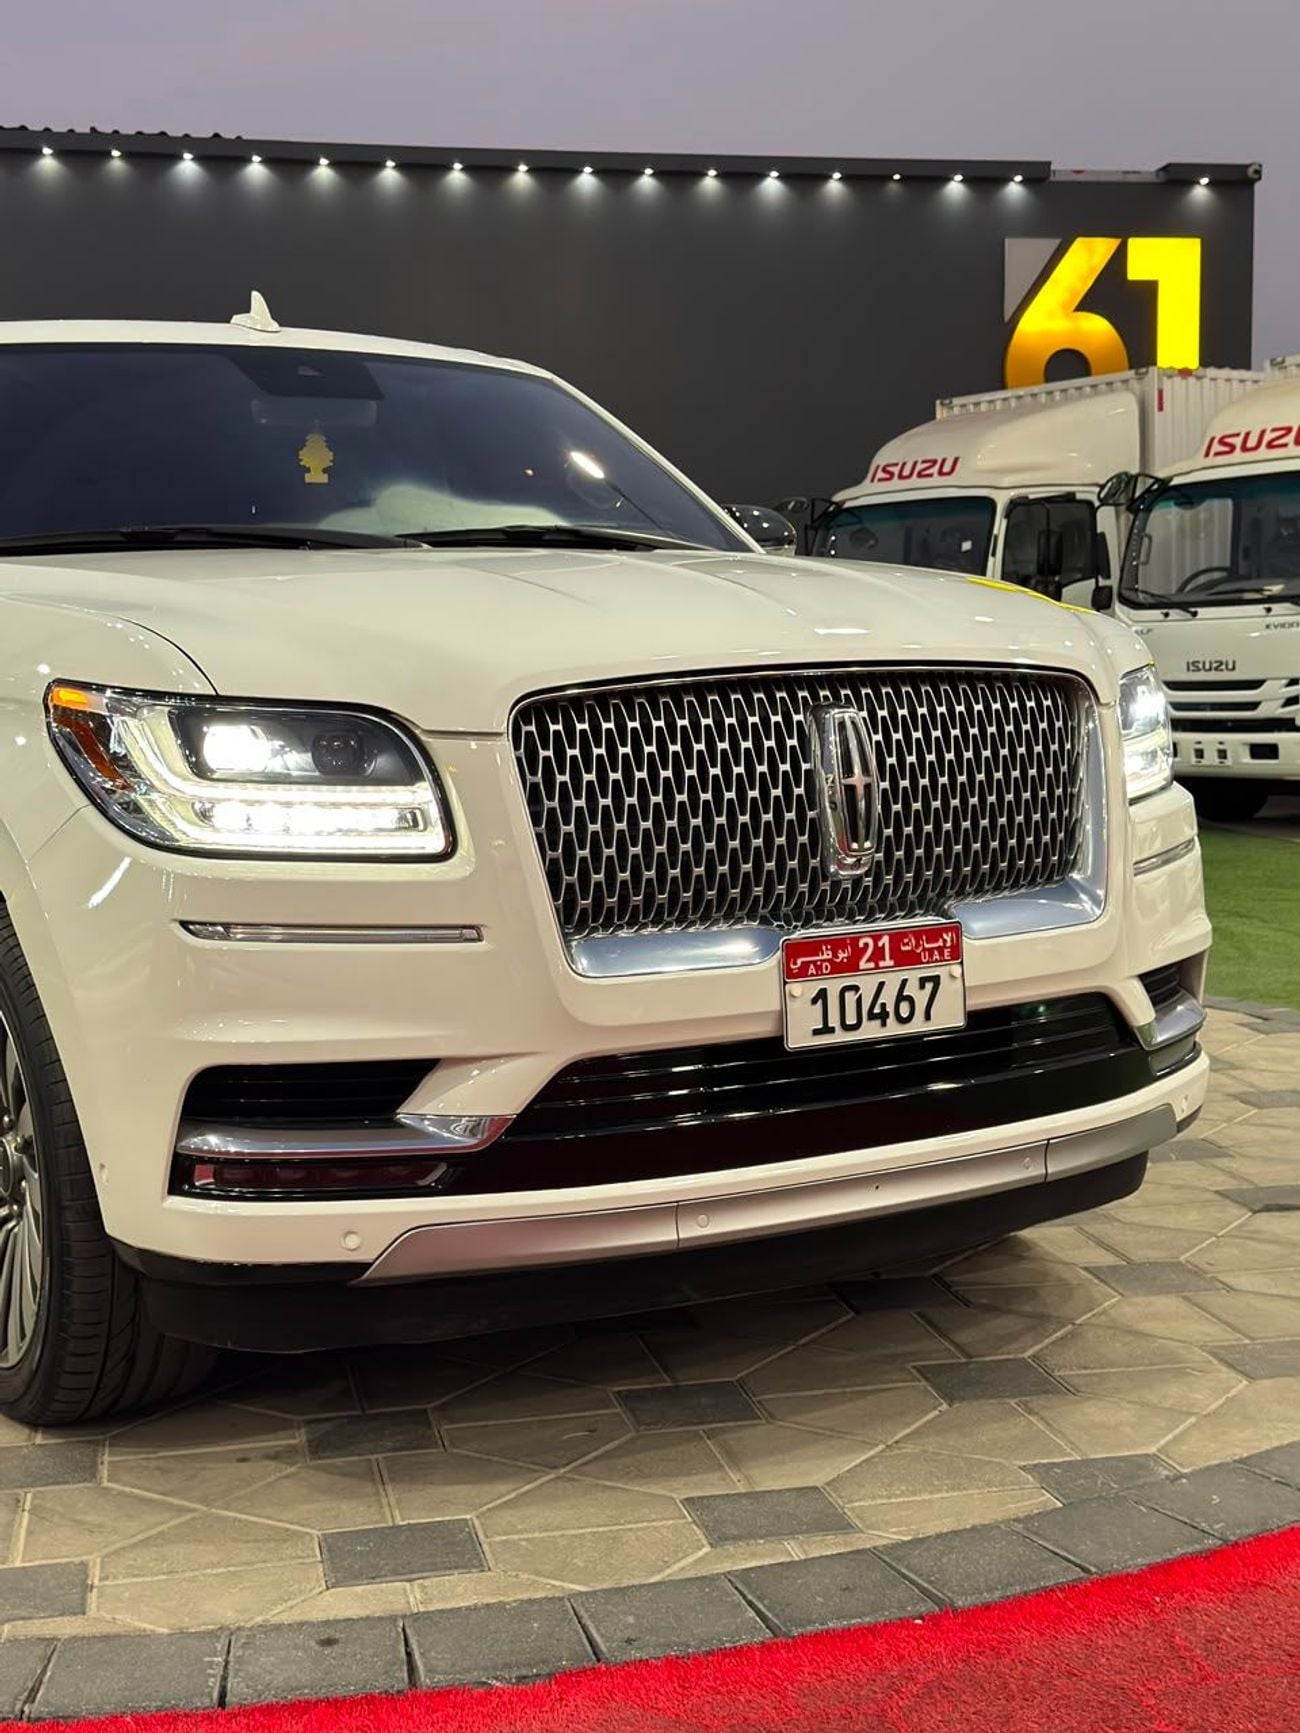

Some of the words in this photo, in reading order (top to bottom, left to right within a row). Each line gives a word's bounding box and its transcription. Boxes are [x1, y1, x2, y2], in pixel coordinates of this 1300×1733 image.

[1004, 237, 1202, 390] 61
[1203, 424, 1300, 459] ISUZ
[869, 456, 960, 483] ISUZU
[1186, 659, 1236, 672] ISUZU
[858, 934, 895, 970] 21
[810, 974, 941, 1036] 10467
